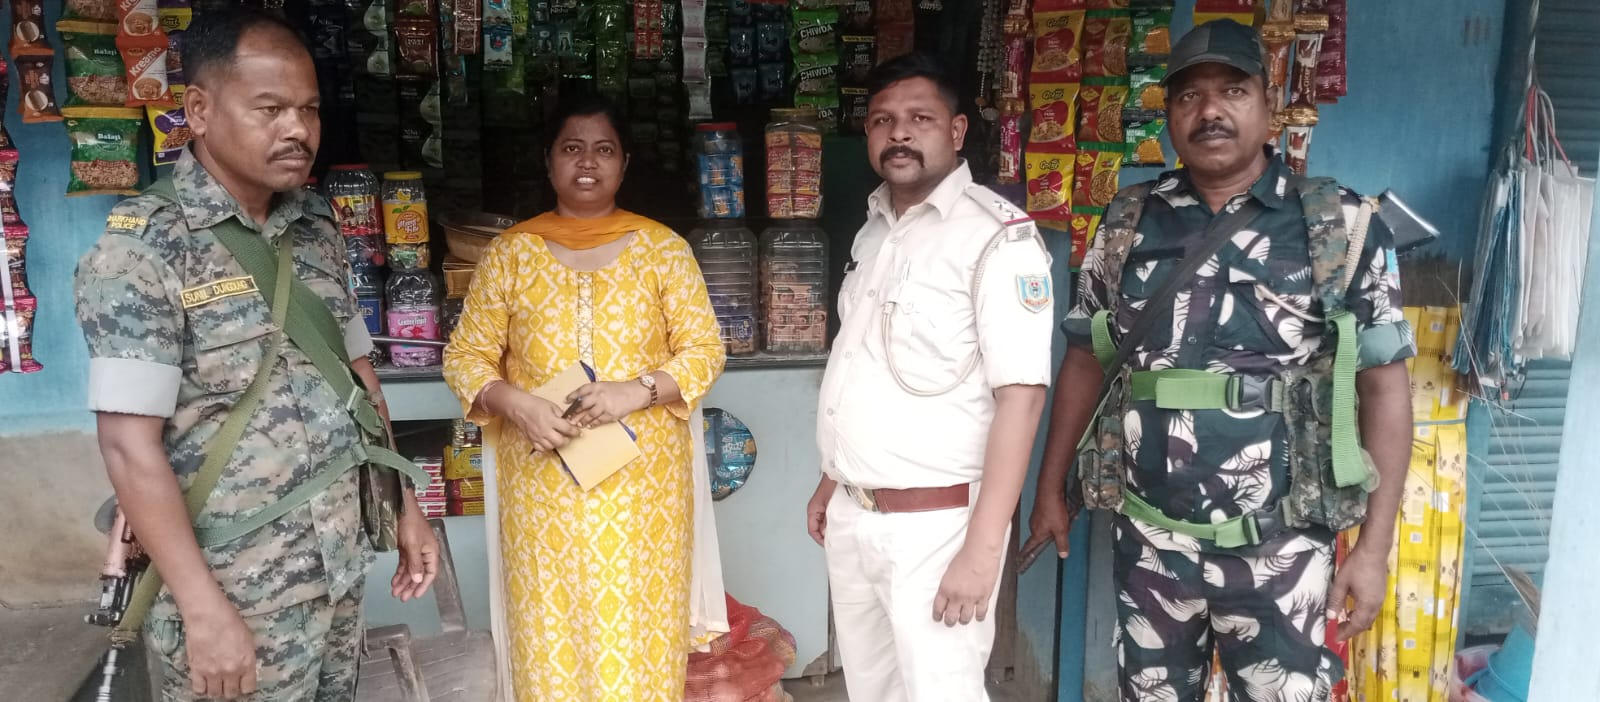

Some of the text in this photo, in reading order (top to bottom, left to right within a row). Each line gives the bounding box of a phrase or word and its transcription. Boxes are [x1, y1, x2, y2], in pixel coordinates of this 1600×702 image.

[799, 24, 834, 39] CHIWDA
[800, 66, 834, 81] CHIWDA
[97, 132, 121, 141] Balaji
[111, 222, 137, 230] POLICE
[184, 289, 210, 304] SUNIL
